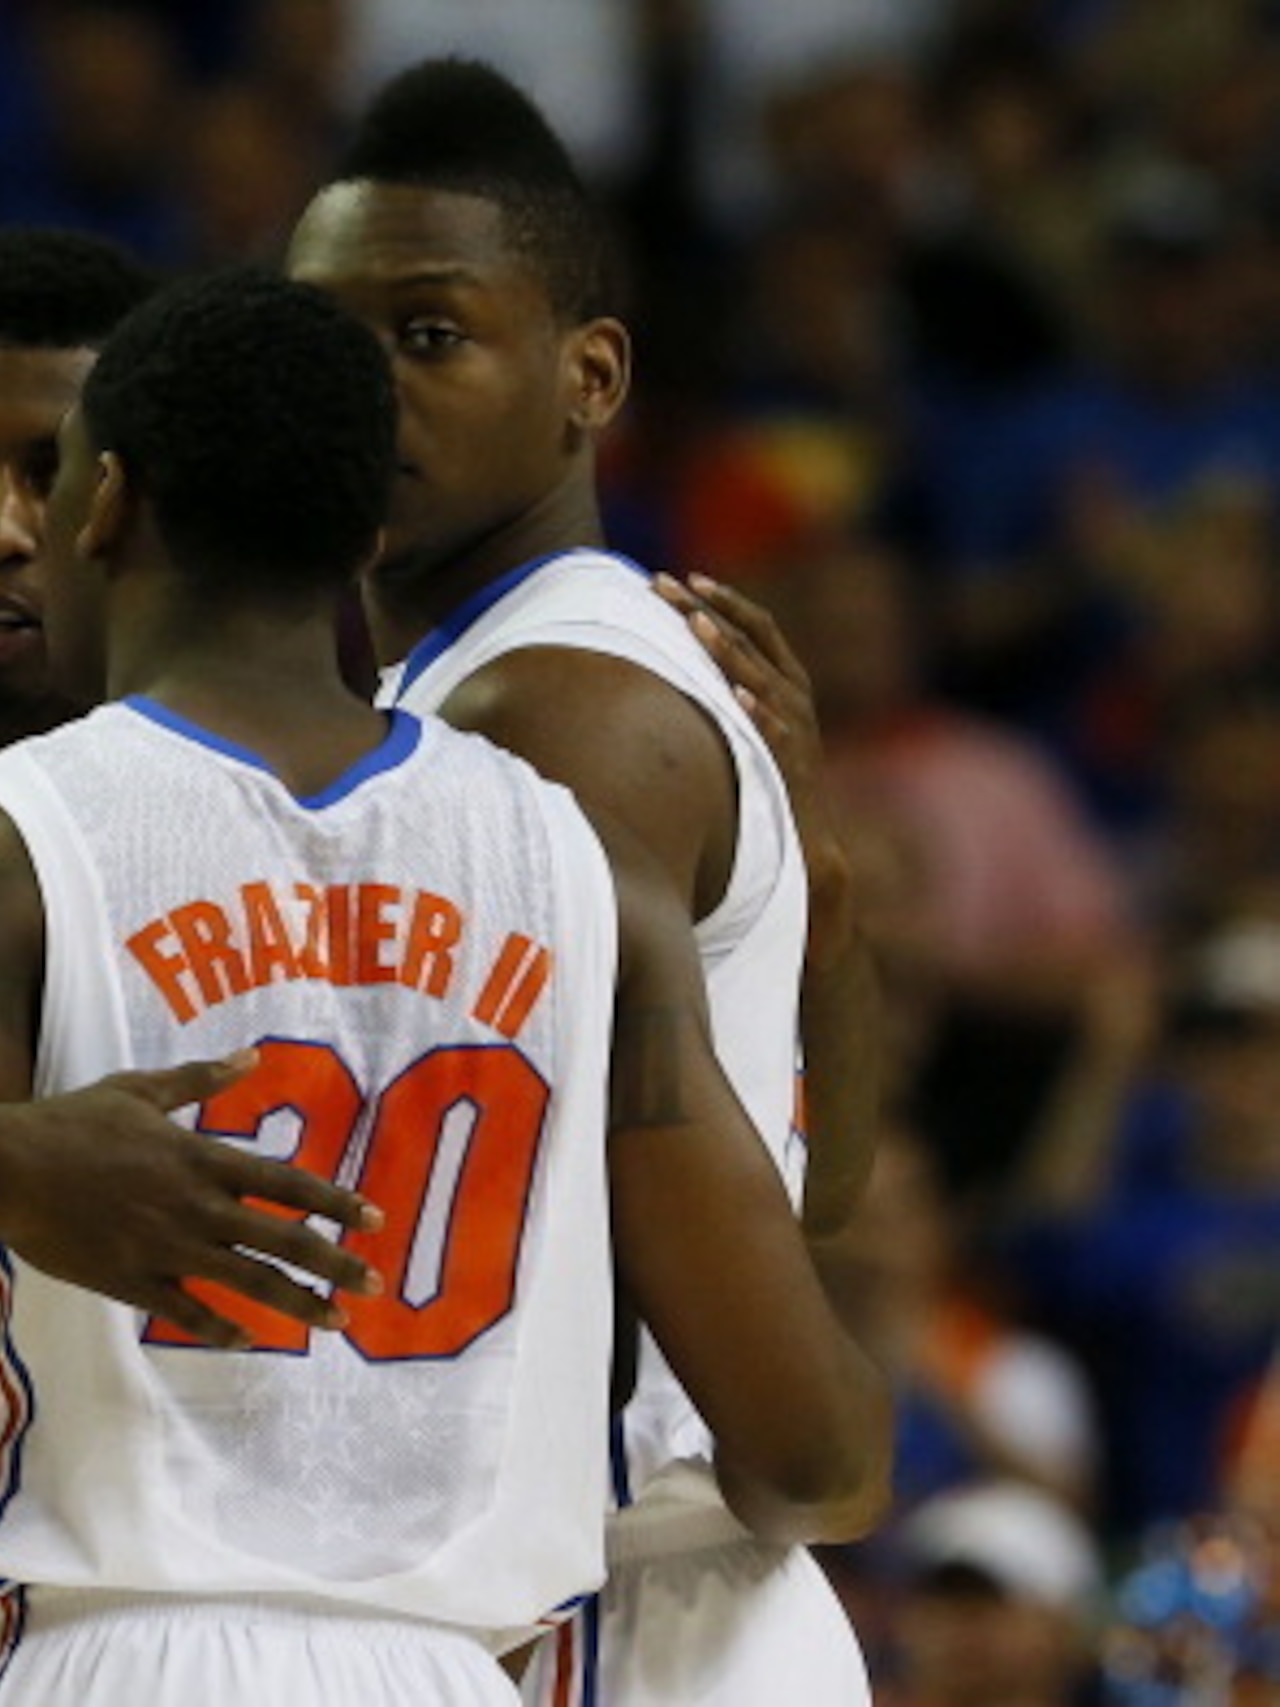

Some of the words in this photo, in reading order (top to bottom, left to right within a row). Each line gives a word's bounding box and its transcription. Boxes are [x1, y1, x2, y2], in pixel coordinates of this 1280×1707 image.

[125, 881, 463, 1025] FRAZIER
[471, 931, 550, 1040] II
[140, 1035, 551, 1364] 20
